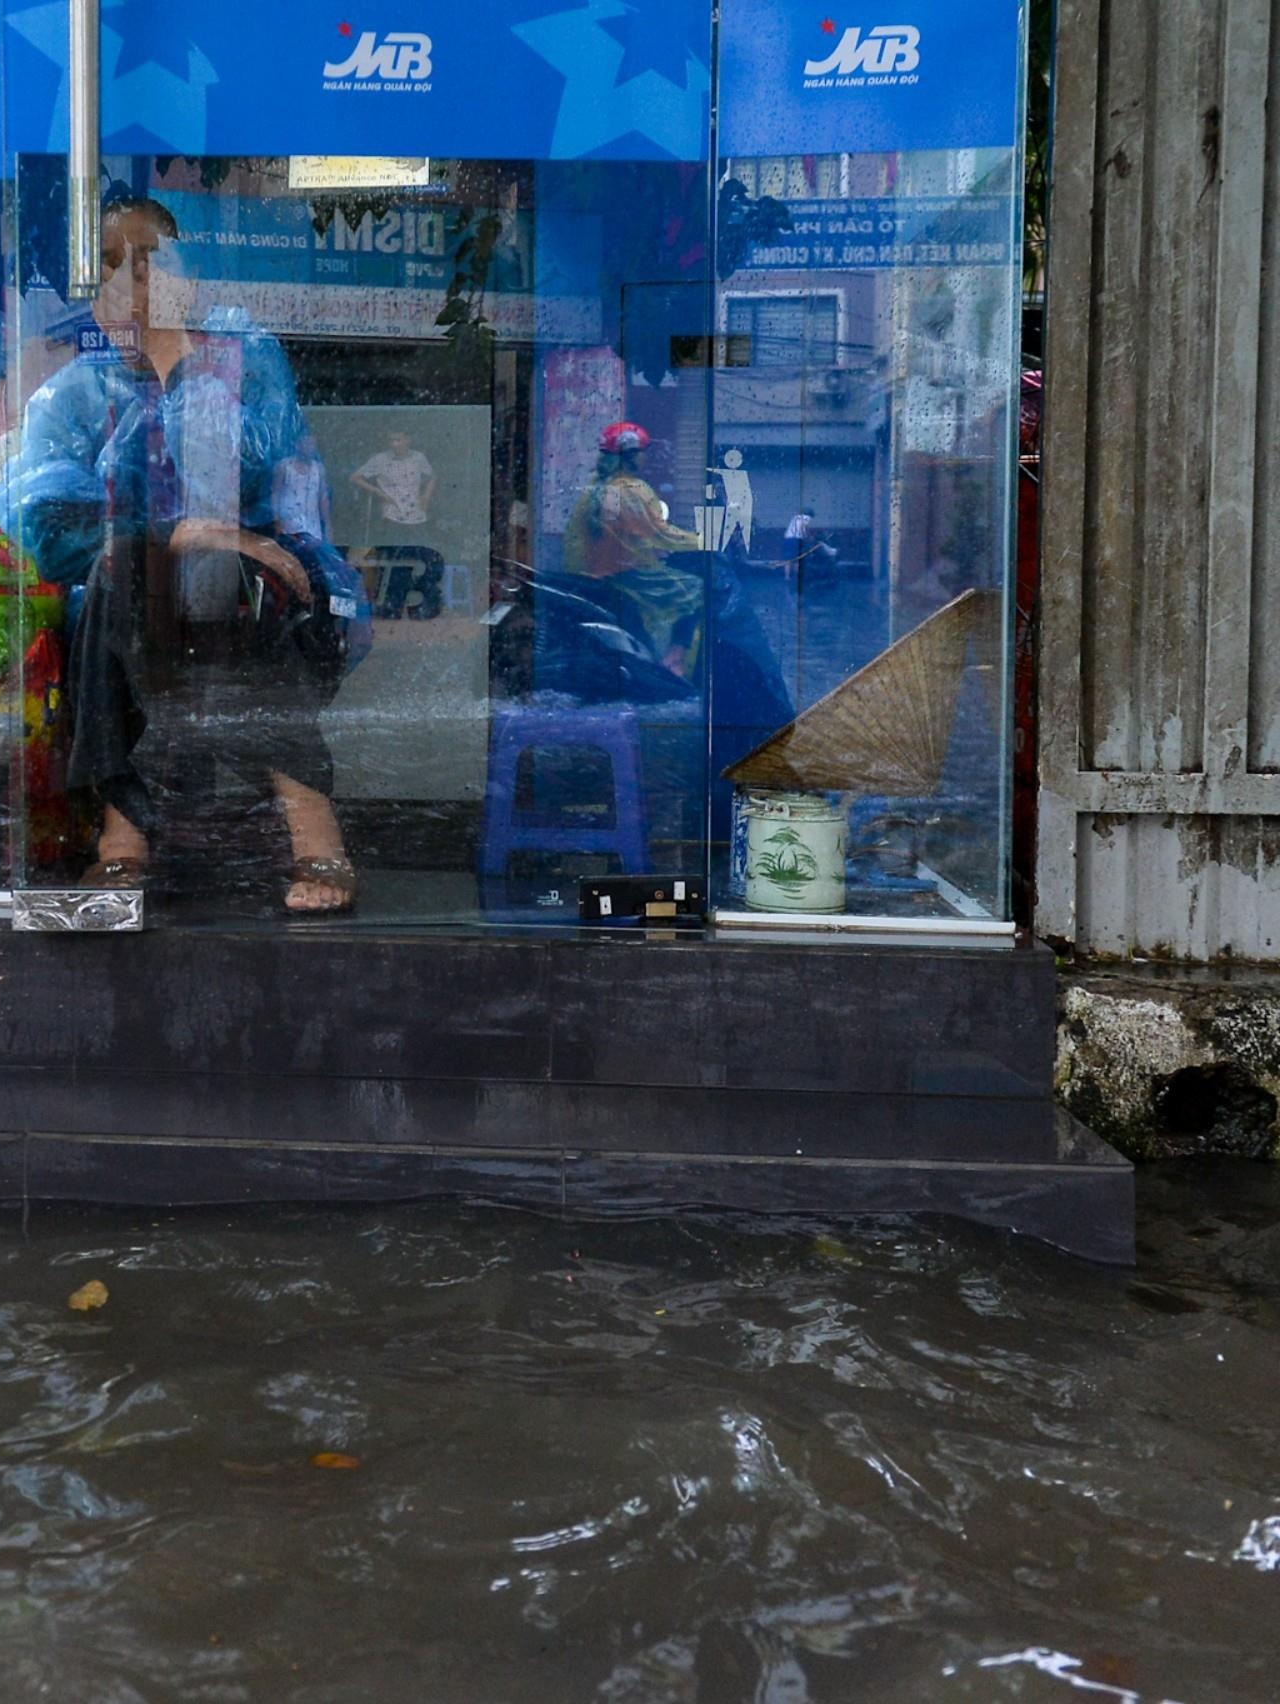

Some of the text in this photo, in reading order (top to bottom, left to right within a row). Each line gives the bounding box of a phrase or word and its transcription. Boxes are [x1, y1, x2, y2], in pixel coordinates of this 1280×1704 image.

[322, 32, 433, 80] MB
[803, 25, 921, 76] MB
[322, 81, 432, 93] NGÂN HÀNG QUÂN ĐỘI
[803, 73, 919, 88] NGÂN HÀNG QUÂN ĐỘI
